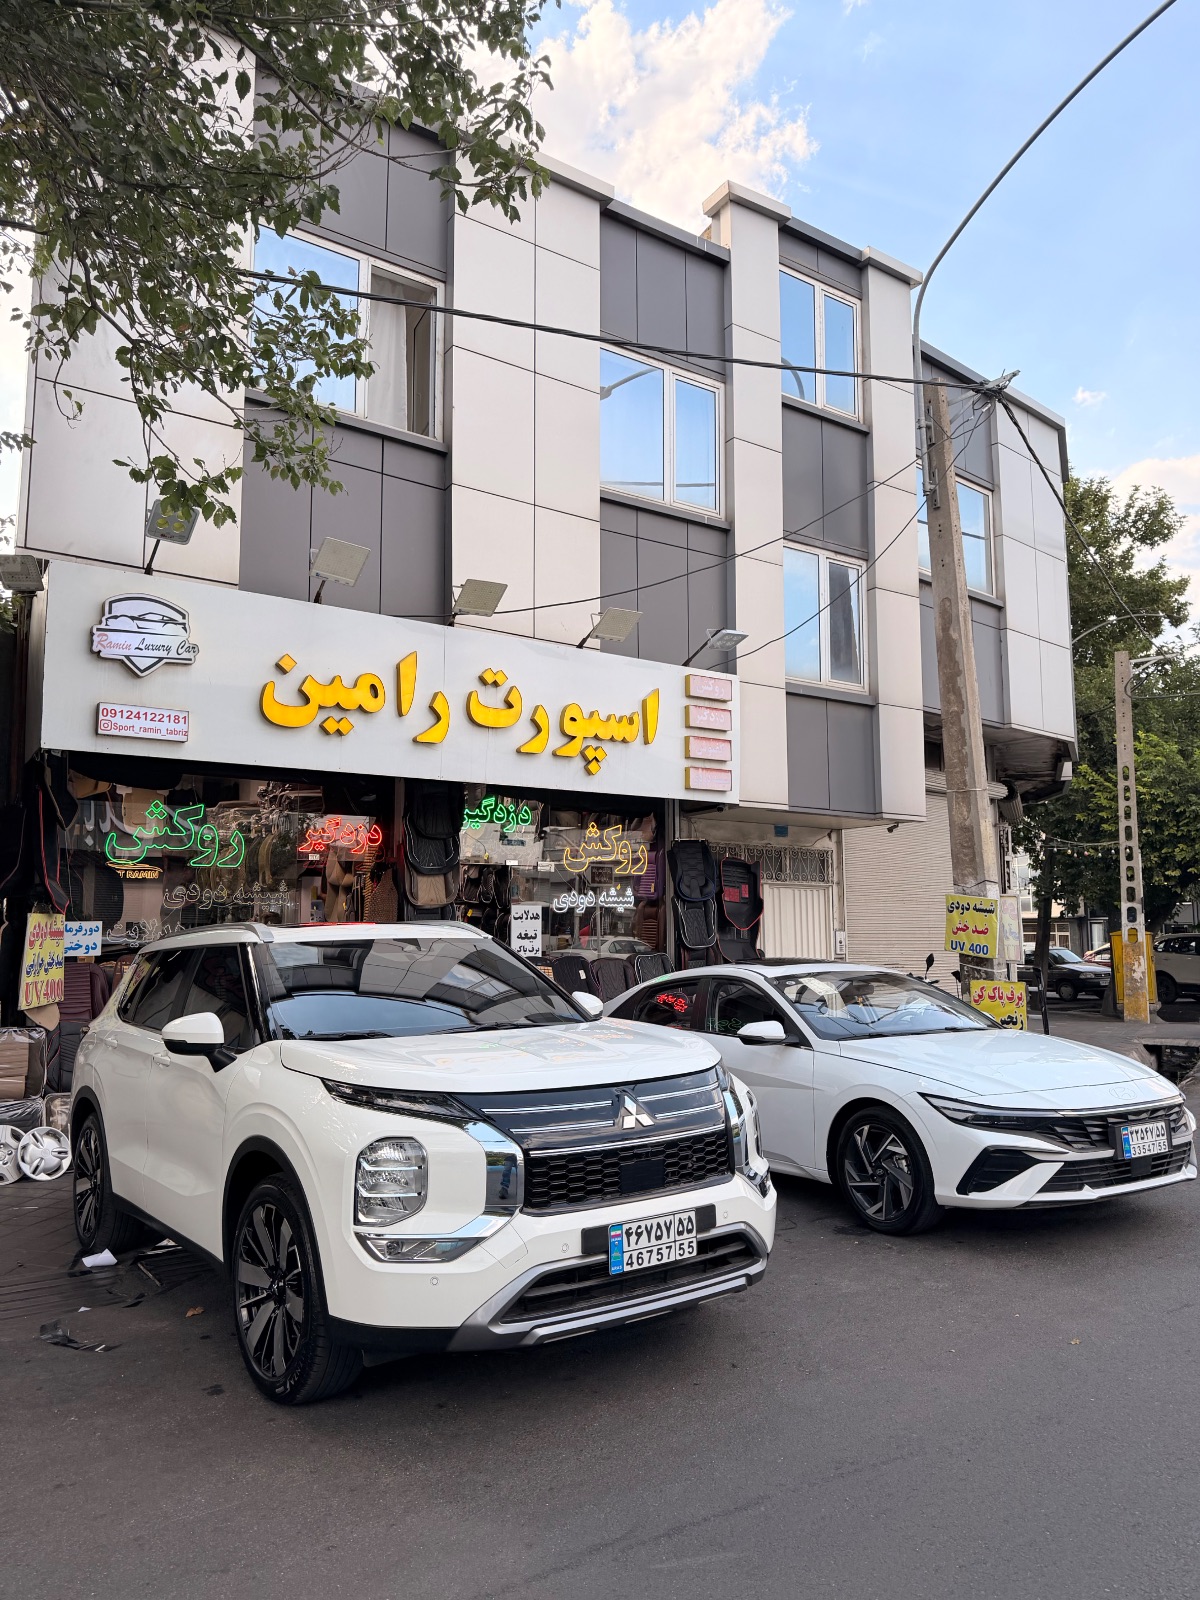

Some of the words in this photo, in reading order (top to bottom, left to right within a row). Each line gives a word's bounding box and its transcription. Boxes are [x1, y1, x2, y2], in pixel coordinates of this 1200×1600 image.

[96, 633, 132, 651] Ramin
[134, 638, 172, 656] Luxury
[176, 640, 197, 656] Car
[260, 651, 450, 743] رامین
[102, 707, 187, 725] 09124122181
[467, 668, 660, 776] اسپورت
[113, 722, 188, 737] Sport_ramin_tabriz
[105, 800, 245, 868] روکش
[563, 822, 648, 875] روکش
[553, 890, 596, 913] دودی
[599, 887, 635, 913] شیشه
[948, 900, 970, 915] دودی
[972, 901, 995, 917] شیشه
[513, 909, 540, 923] هدلایت
[65, 923, 83, 937] فرما
[517, 930, 537, 943] تیغه
[952, 920, 969, 935] خش
[972, 923, 989, 935] ضد
[528, 945, 540, 955] برف
[951, 940, 965, 951] UV
[969, 942, 989, 955] 400
[25, 980, 44, 1006] UV
[43, 978, 63, 1003] 400
[973, 985, 986, 1005] کن
[988, 985, 1005, 1007] پاک
[1006, 985, 1024, 1008] برف
[1132, 1142, 1155, 1156] 33547
[1157, 1141, 1167, 1151] 55
[625, 1219, 673, 1248] ۴۶۷۵۷
[676, 1215, 695, 1236] ۵۵
[626, 1245, 673, 1268] 46757
[678, 1241, 695, 1257] 55
